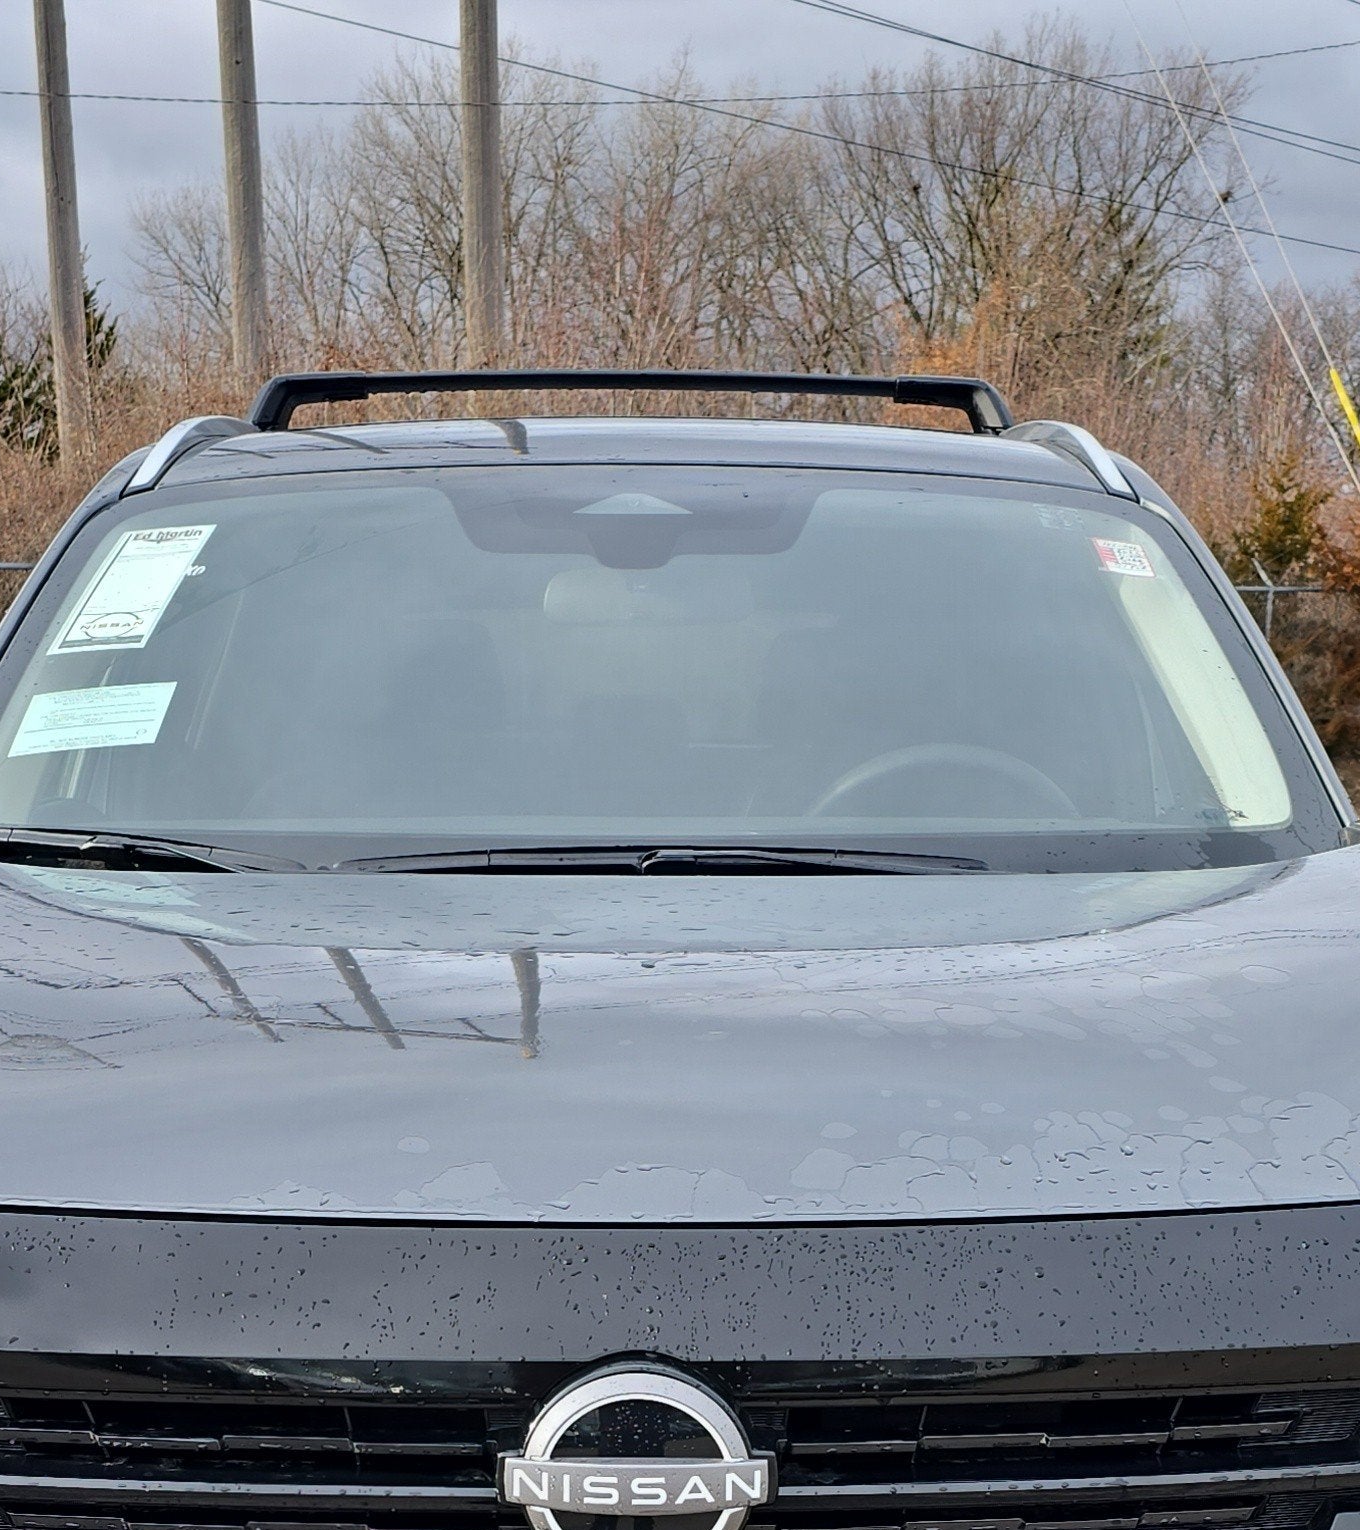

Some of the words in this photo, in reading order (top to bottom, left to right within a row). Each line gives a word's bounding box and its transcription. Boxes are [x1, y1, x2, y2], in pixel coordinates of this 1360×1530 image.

[133, 532, 153, 541] Ed
[80, 620, 143, 630] NISSAN
[512, 1468, 761, 1505] NISSAN
